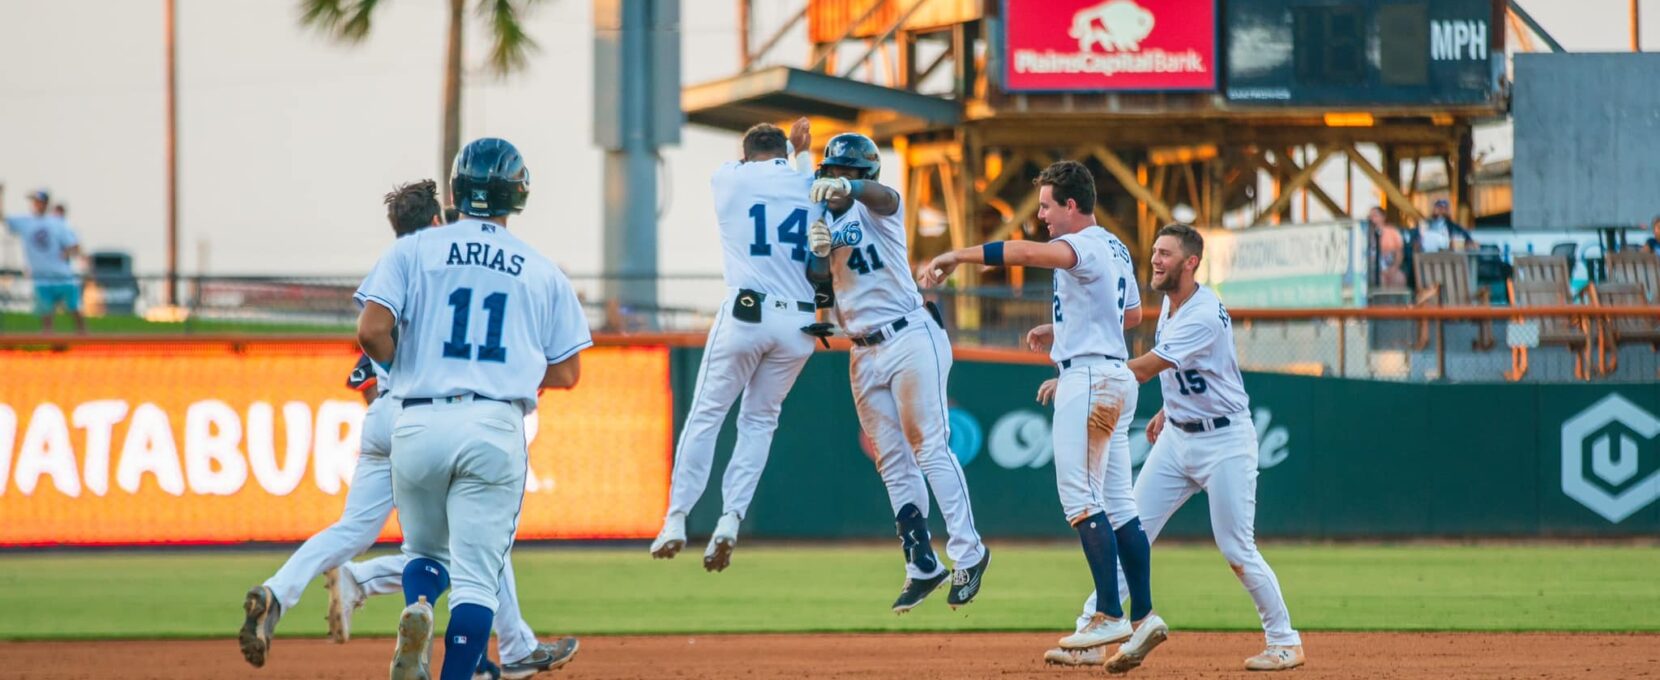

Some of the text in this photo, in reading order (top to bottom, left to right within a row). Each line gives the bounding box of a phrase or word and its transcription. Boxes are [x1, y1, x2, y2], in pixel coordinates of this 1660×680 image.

[1430, 20, 1487, 60] MPH
[748, 203, 808, 262] 14
[446, 242, 525, 276] ARIAS
[847, 244, 884, 275] 41
[442, 287, 508, 363] 11
[1175, 368, 1207, 395] 15
